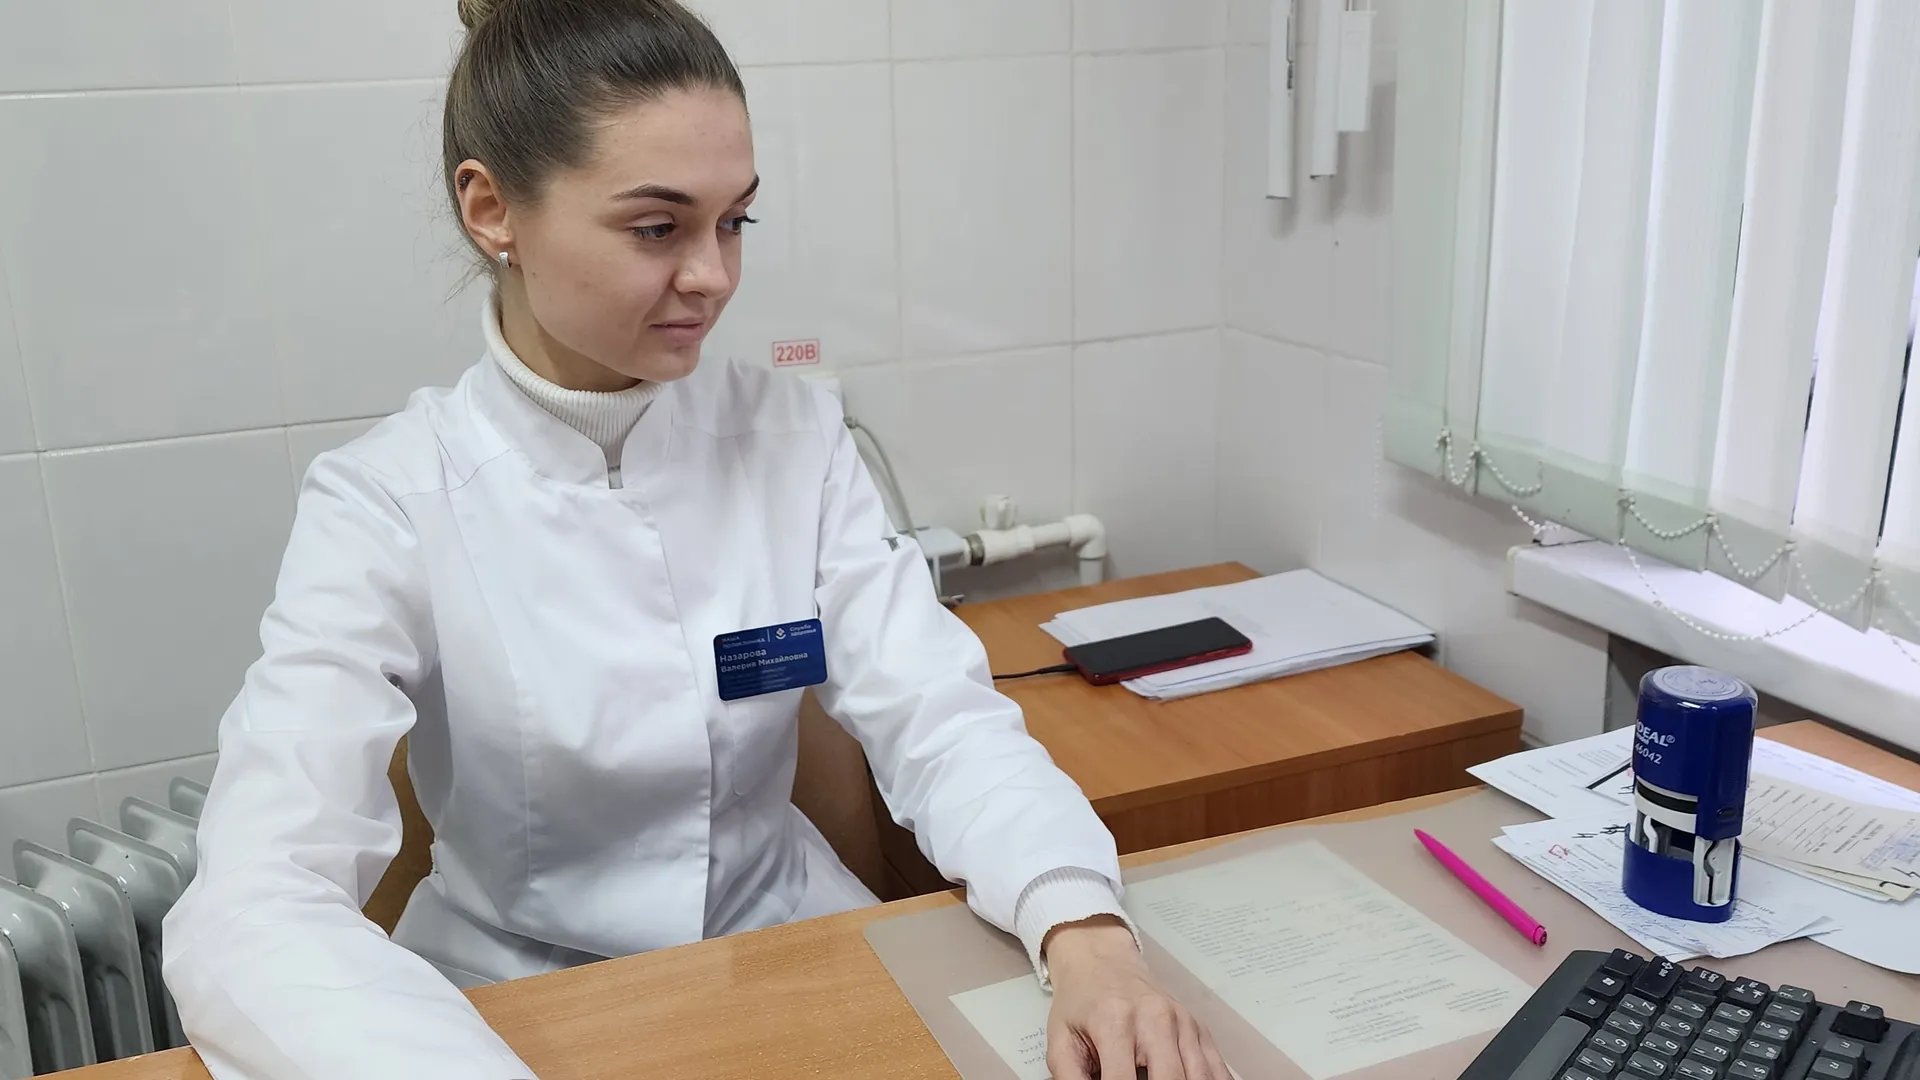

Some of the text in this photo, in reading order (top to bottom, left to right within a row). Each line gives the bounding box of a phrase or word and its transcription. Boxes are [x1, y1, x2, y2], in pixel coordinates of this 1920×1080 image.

[776, 344, 816, 362] 220В
[720, 648, 767, 663] Назарова
[720, 652, 808, 673] Валерия Михайловна
[1635, 743, 1662, 764] 46042
[1642, 1001, 1654, 1011] Z
[1691, 1003, 1703, 1012] A
[1737, 1009, 1751, 1017] Q
[1628, 1019, 1641, 1029] X
[1678, 1022, 1691, 1031] S
[1760, 1021, 1771, 1029] 2
[1726, 1026, 1740, 1037] W
[1665, 1040, 1678, 1050] D
[1748, 1040, 1760, 1048] 3
[1713, 1046, 1727, 1055] E
[1601, 1056, 1614, 1066] V
[1652, 1059, 1665, 1069] F
[1736, 1060, 1748, 1068] 4
[1700, 1065, 1714, 1075] R
